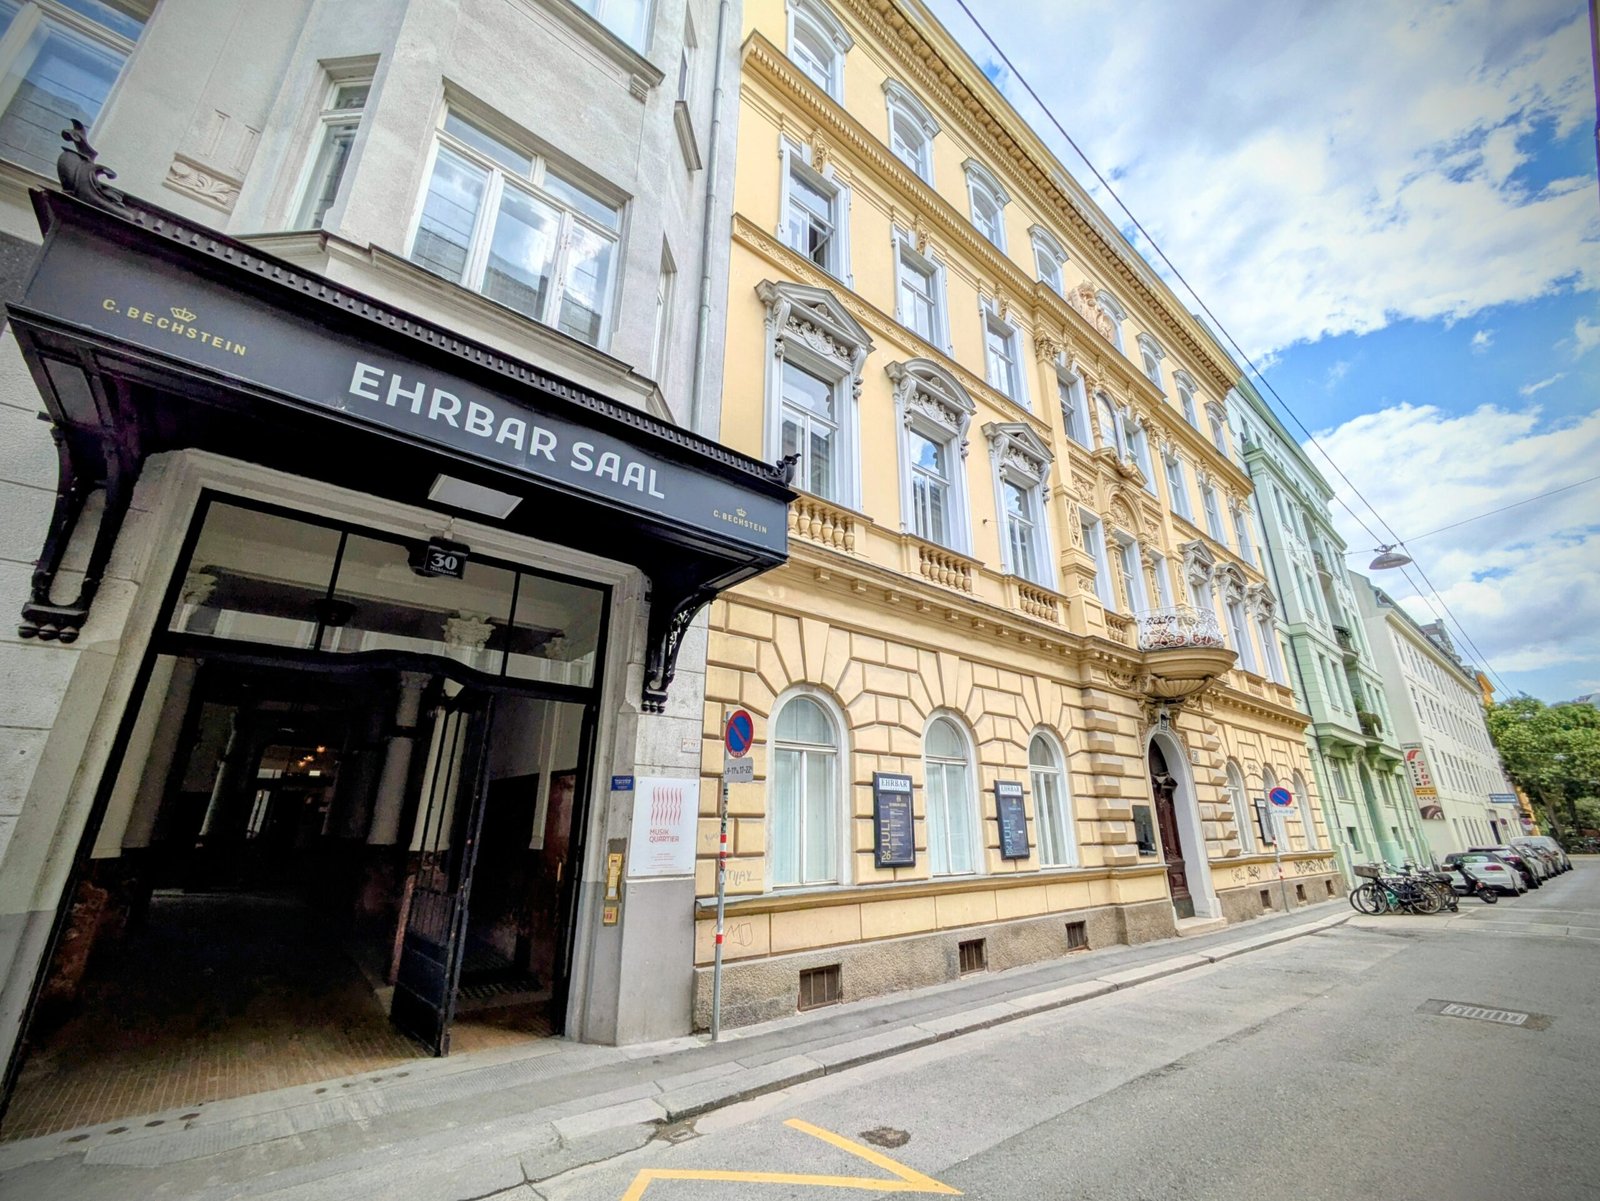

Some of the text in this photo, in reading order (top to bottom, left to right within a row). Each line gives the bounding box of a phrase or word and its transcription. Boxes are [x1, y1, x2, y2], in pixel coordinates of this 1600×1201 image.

[102, 298, 247, 356] C. BECHSTEIN
[349, 361, 665, 500] EHRBAR SAAL
[722, 512, 767, 535] BECHSTEIN
[430, 552, 458, 570] 30
[881, 778, 908, 788] EHRBAR
[649, 828, 670, 836] MUSIK
[649, 835, 680, 844] QUARTIER
[880, 819, 891, 849] JULI
